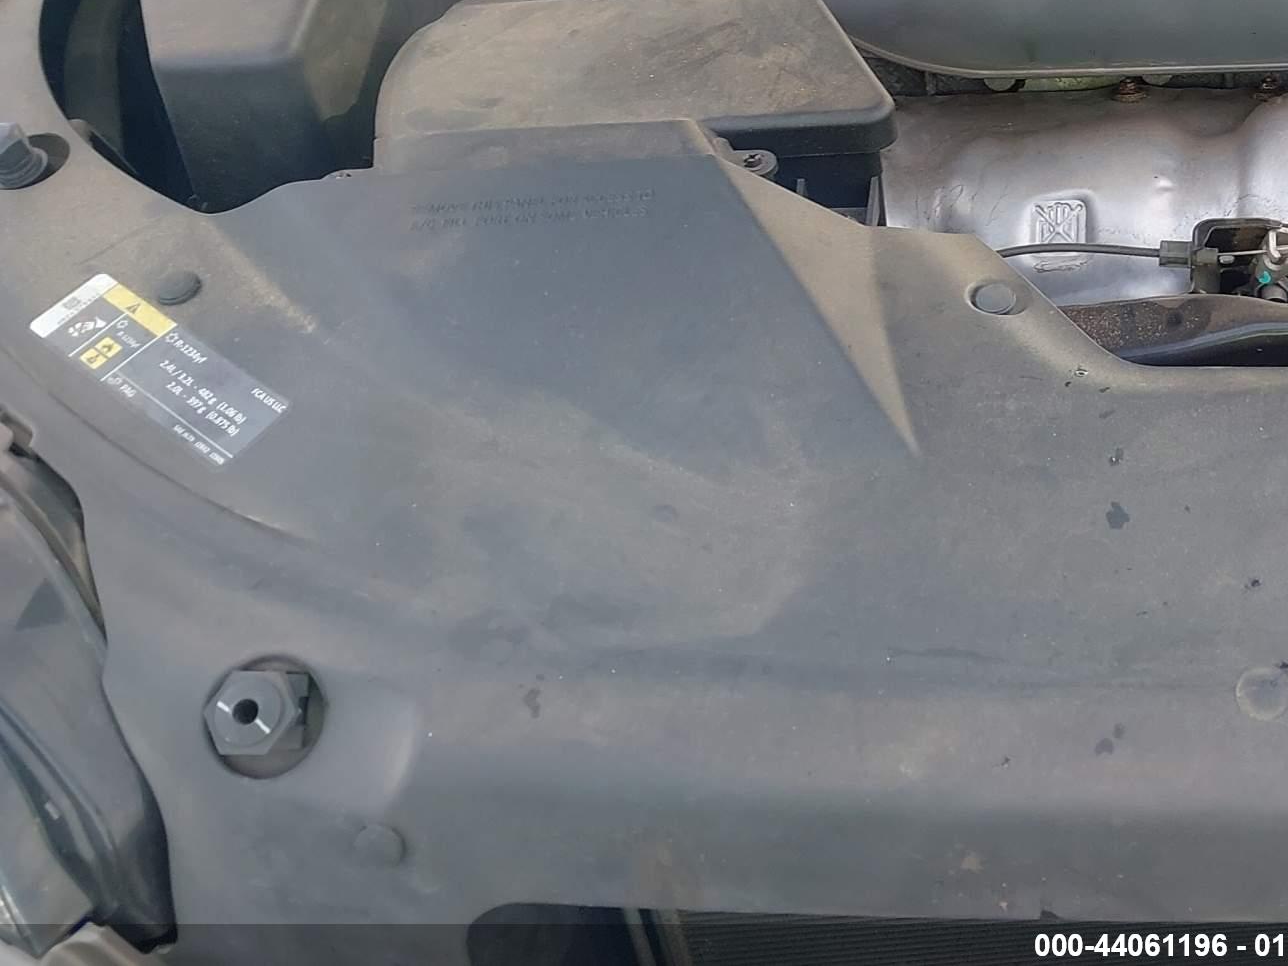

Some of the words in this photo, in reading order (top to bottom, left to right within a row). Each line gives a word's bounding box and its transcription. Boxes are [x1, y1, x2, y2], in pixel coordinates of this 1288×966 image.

[173, 339, 208, 364] R-1234yf
[120, 384, 136, 398] PAG
[250, 388, 266, 401] FCA
[263, 395, 276, 406] US
[271, 401, 287, 414] LLC
